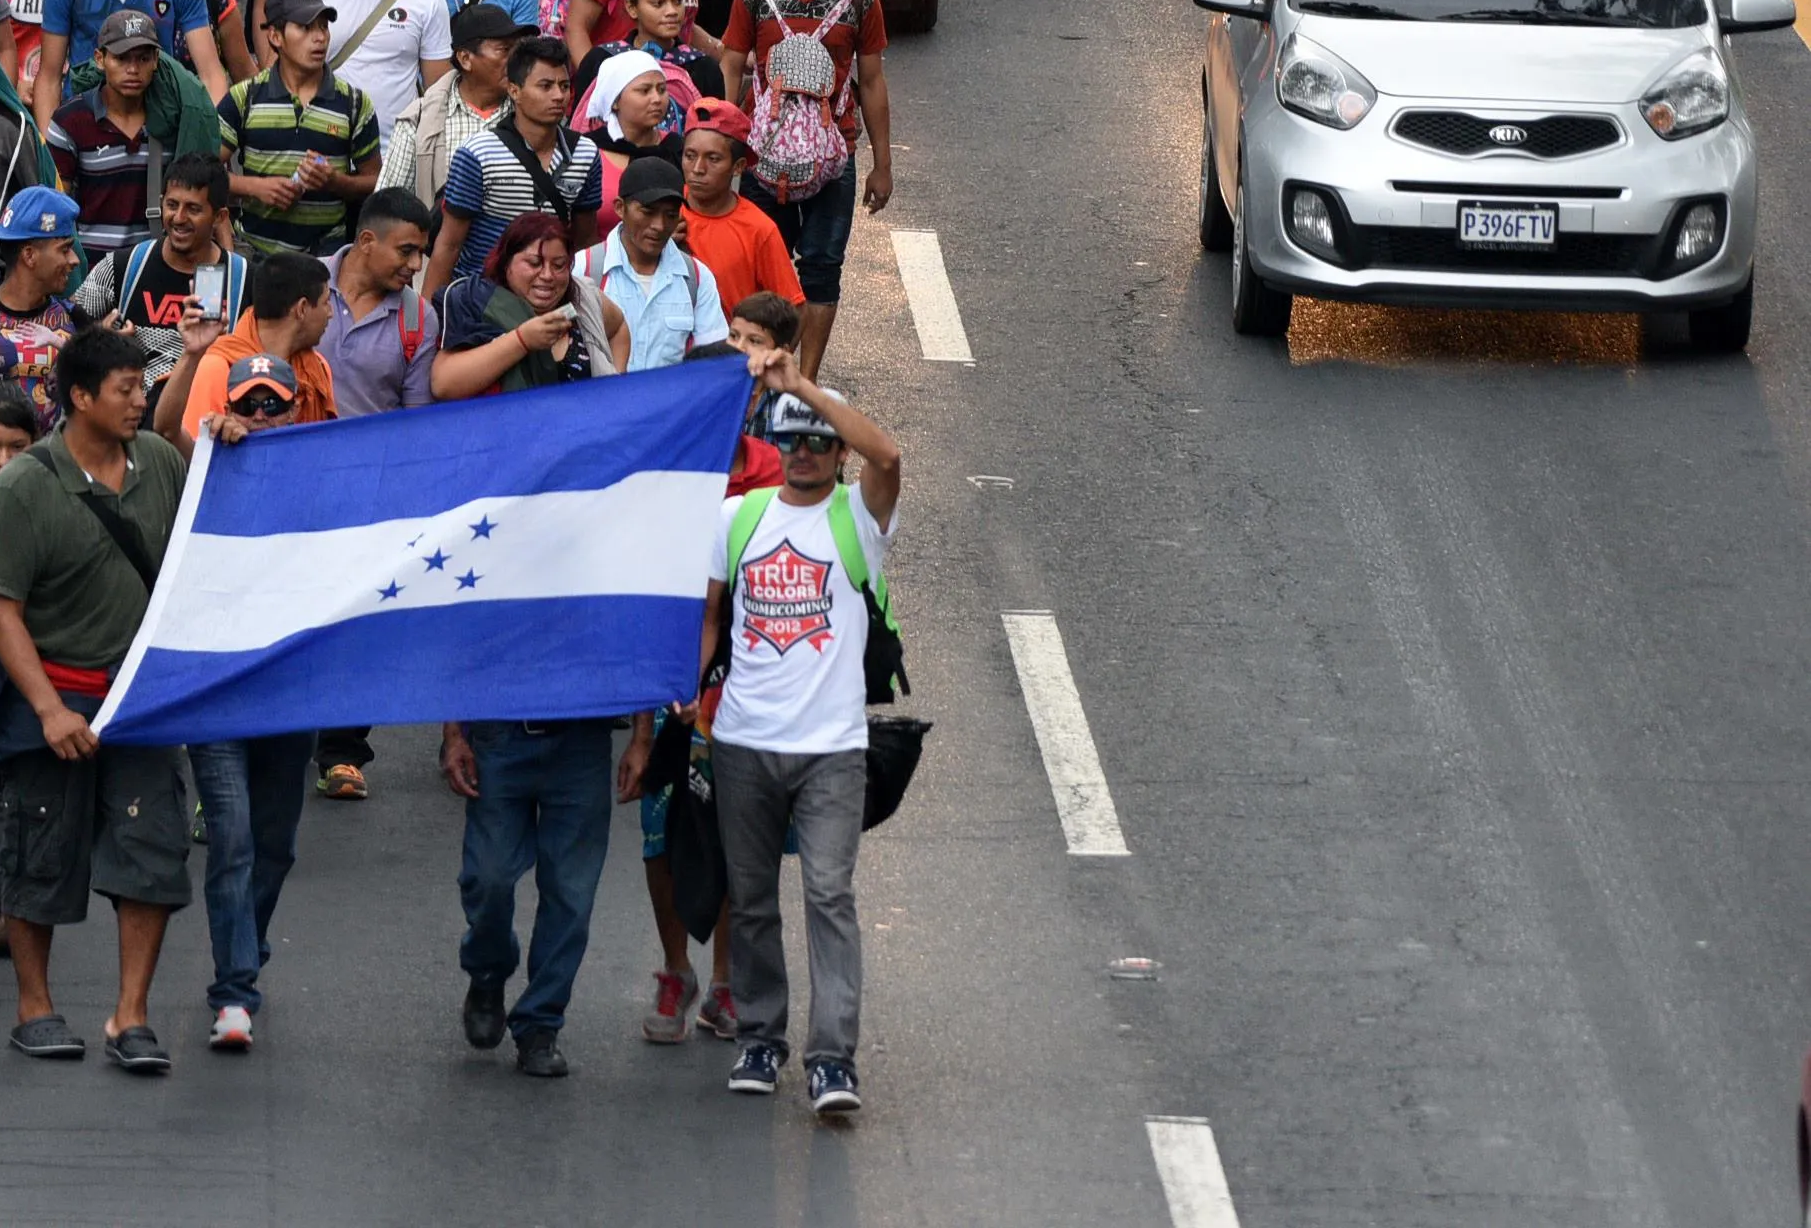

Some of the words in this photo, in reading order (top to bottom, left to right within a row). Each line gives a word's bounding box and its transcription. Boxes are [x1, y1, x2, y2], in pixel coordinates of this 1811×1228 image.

[1494, 127, 1522, 142] KIA
[1464, 212, 1553, 239] P396FTV
[750, 563, 817, 585] TRUE
[752, 583, 817, 600] COLORS
[744, 597, 830, 617] HOMECOMING
[764, 619, 802, 633] 2012
